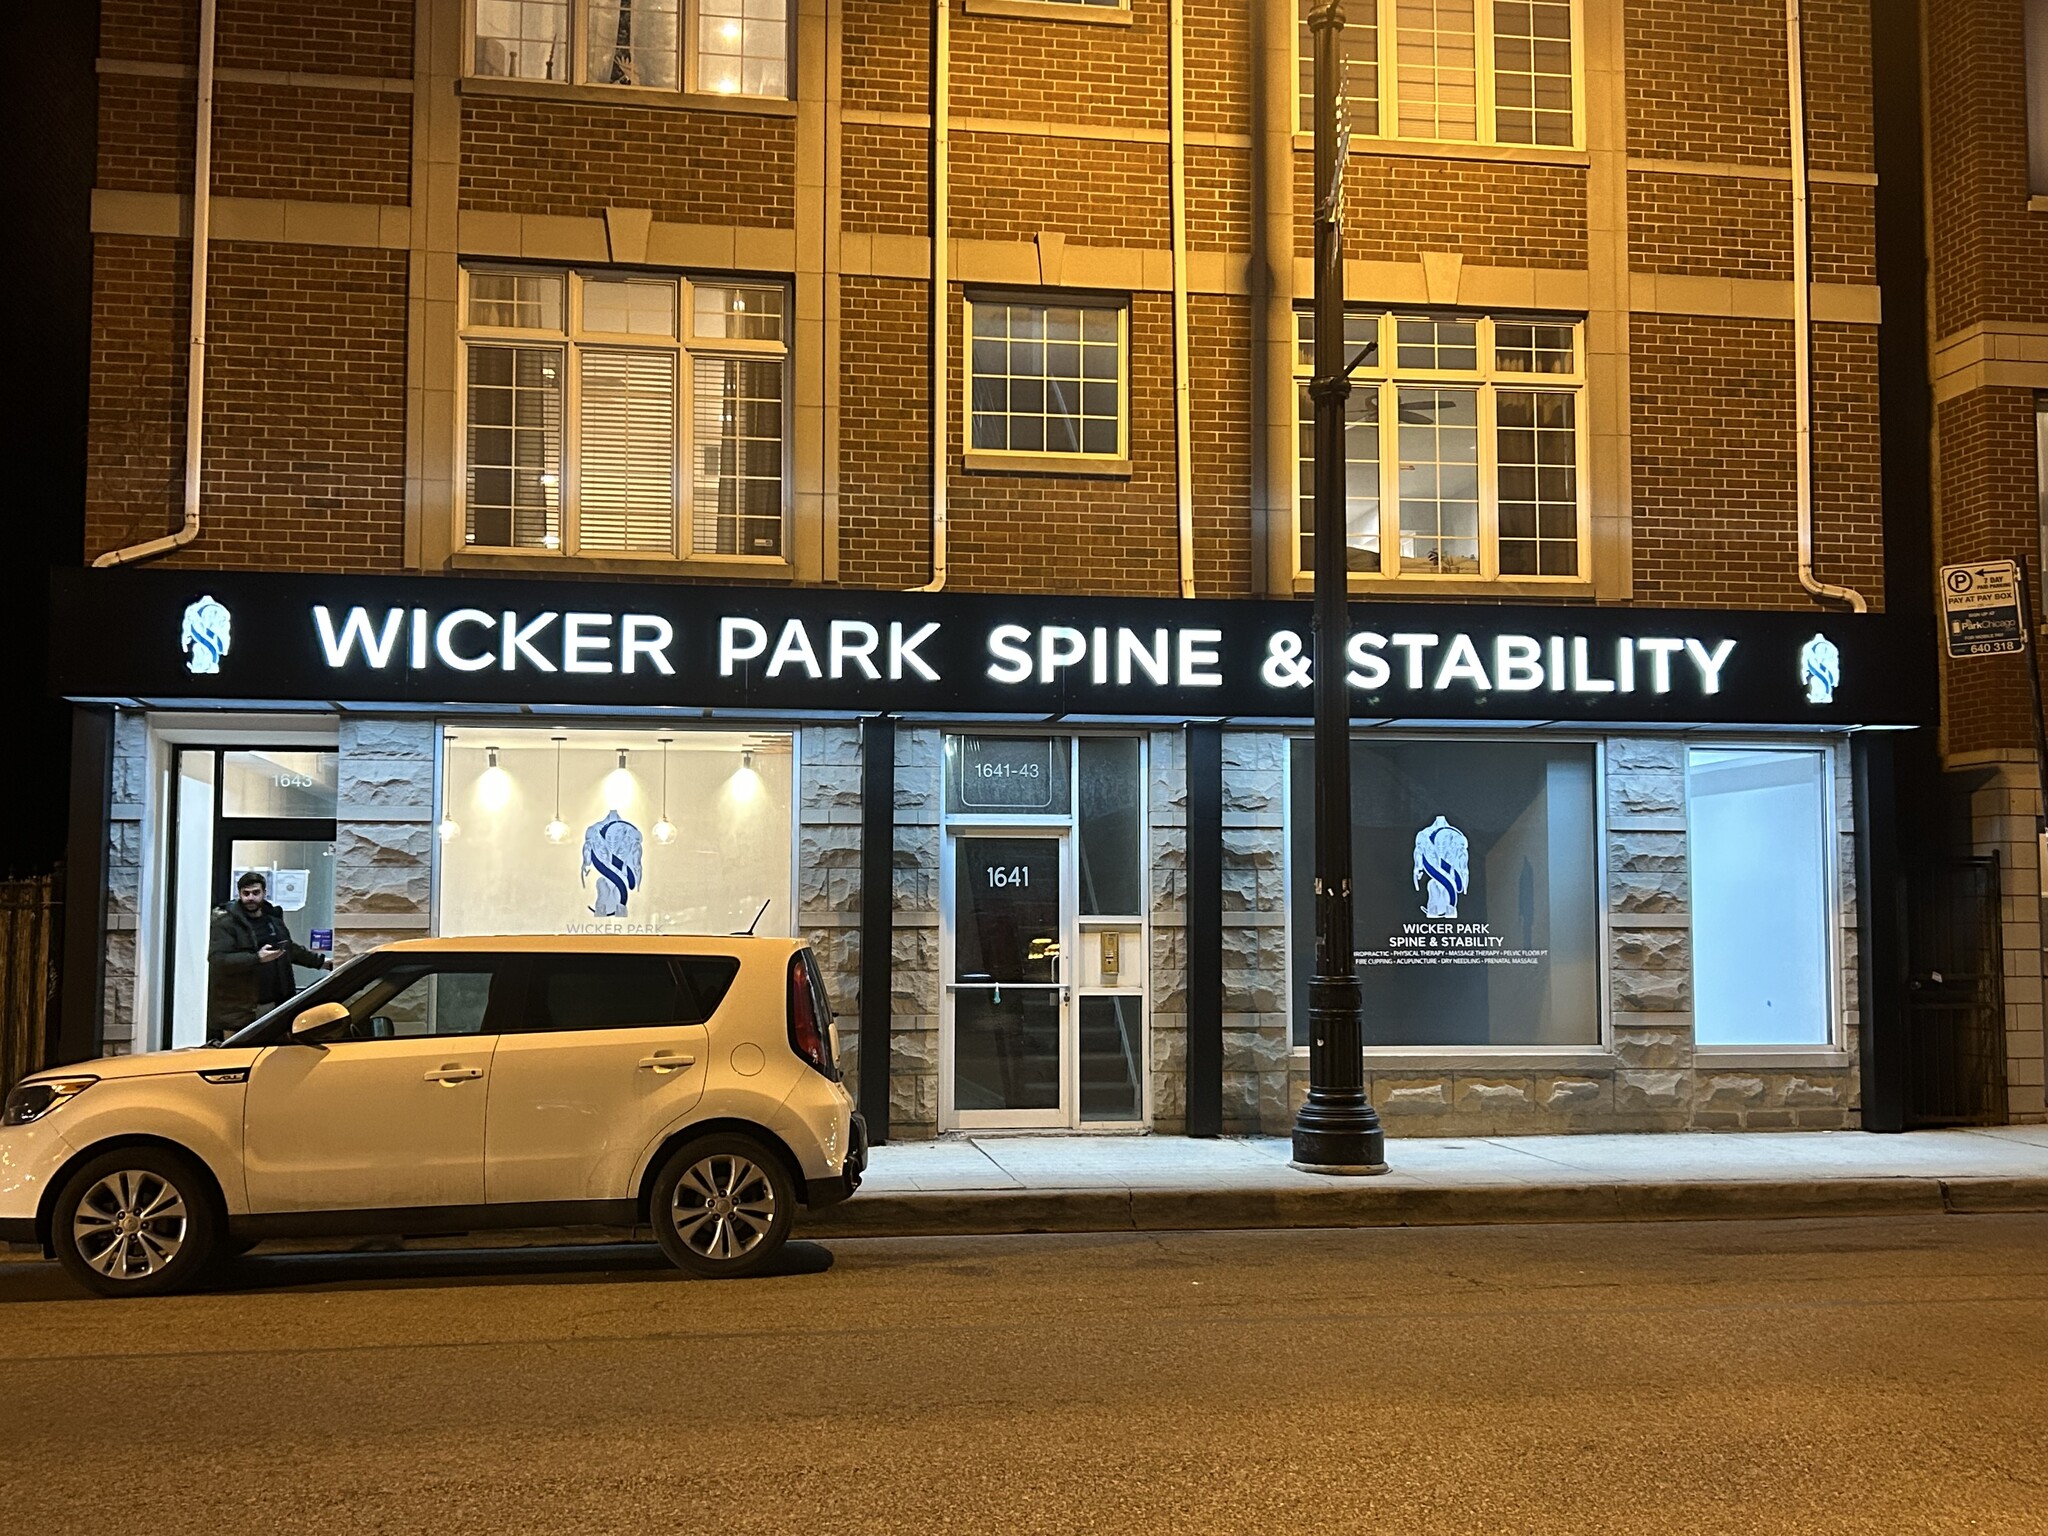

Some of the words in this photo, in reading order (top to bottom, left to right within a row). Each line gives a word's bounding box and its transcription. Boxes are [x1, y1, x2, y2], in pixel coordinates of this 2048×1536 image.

[1955, 574, 1967, 589] P
[1948, 597, 1964, 605] PAY
[1977, 594, 1993, 602] PAY
[1995, 592, 2013, 600] BOX
[313, 604, 676, 676] WICKER
[719, 616, 942, 682] PARK
[986, 624, 1223, 687] SPINE
[1262, 630, 1314, 688] &
[1345, 632, 1737, 695] STABILITY
[1970, 643, 1991, 654] 640
[1993, 641, 2014, 652] 318
[975, 763, 1040, 778] 1641-43
[273, 774, 312, 788] 1643
[987, 866, 1029, 887] 1641
[566, 923, 623, 934] WICKER
[627, 923, 664, 934] PARK
[1403, 923, 1453, 934] WICKER
[1456, 923, 1490, 934] PARK
[1389, 936, 1426, 948] SPINE
[1429, 936, 1438, 948] &
[1441, 936, 1504, 948] STABILITY
